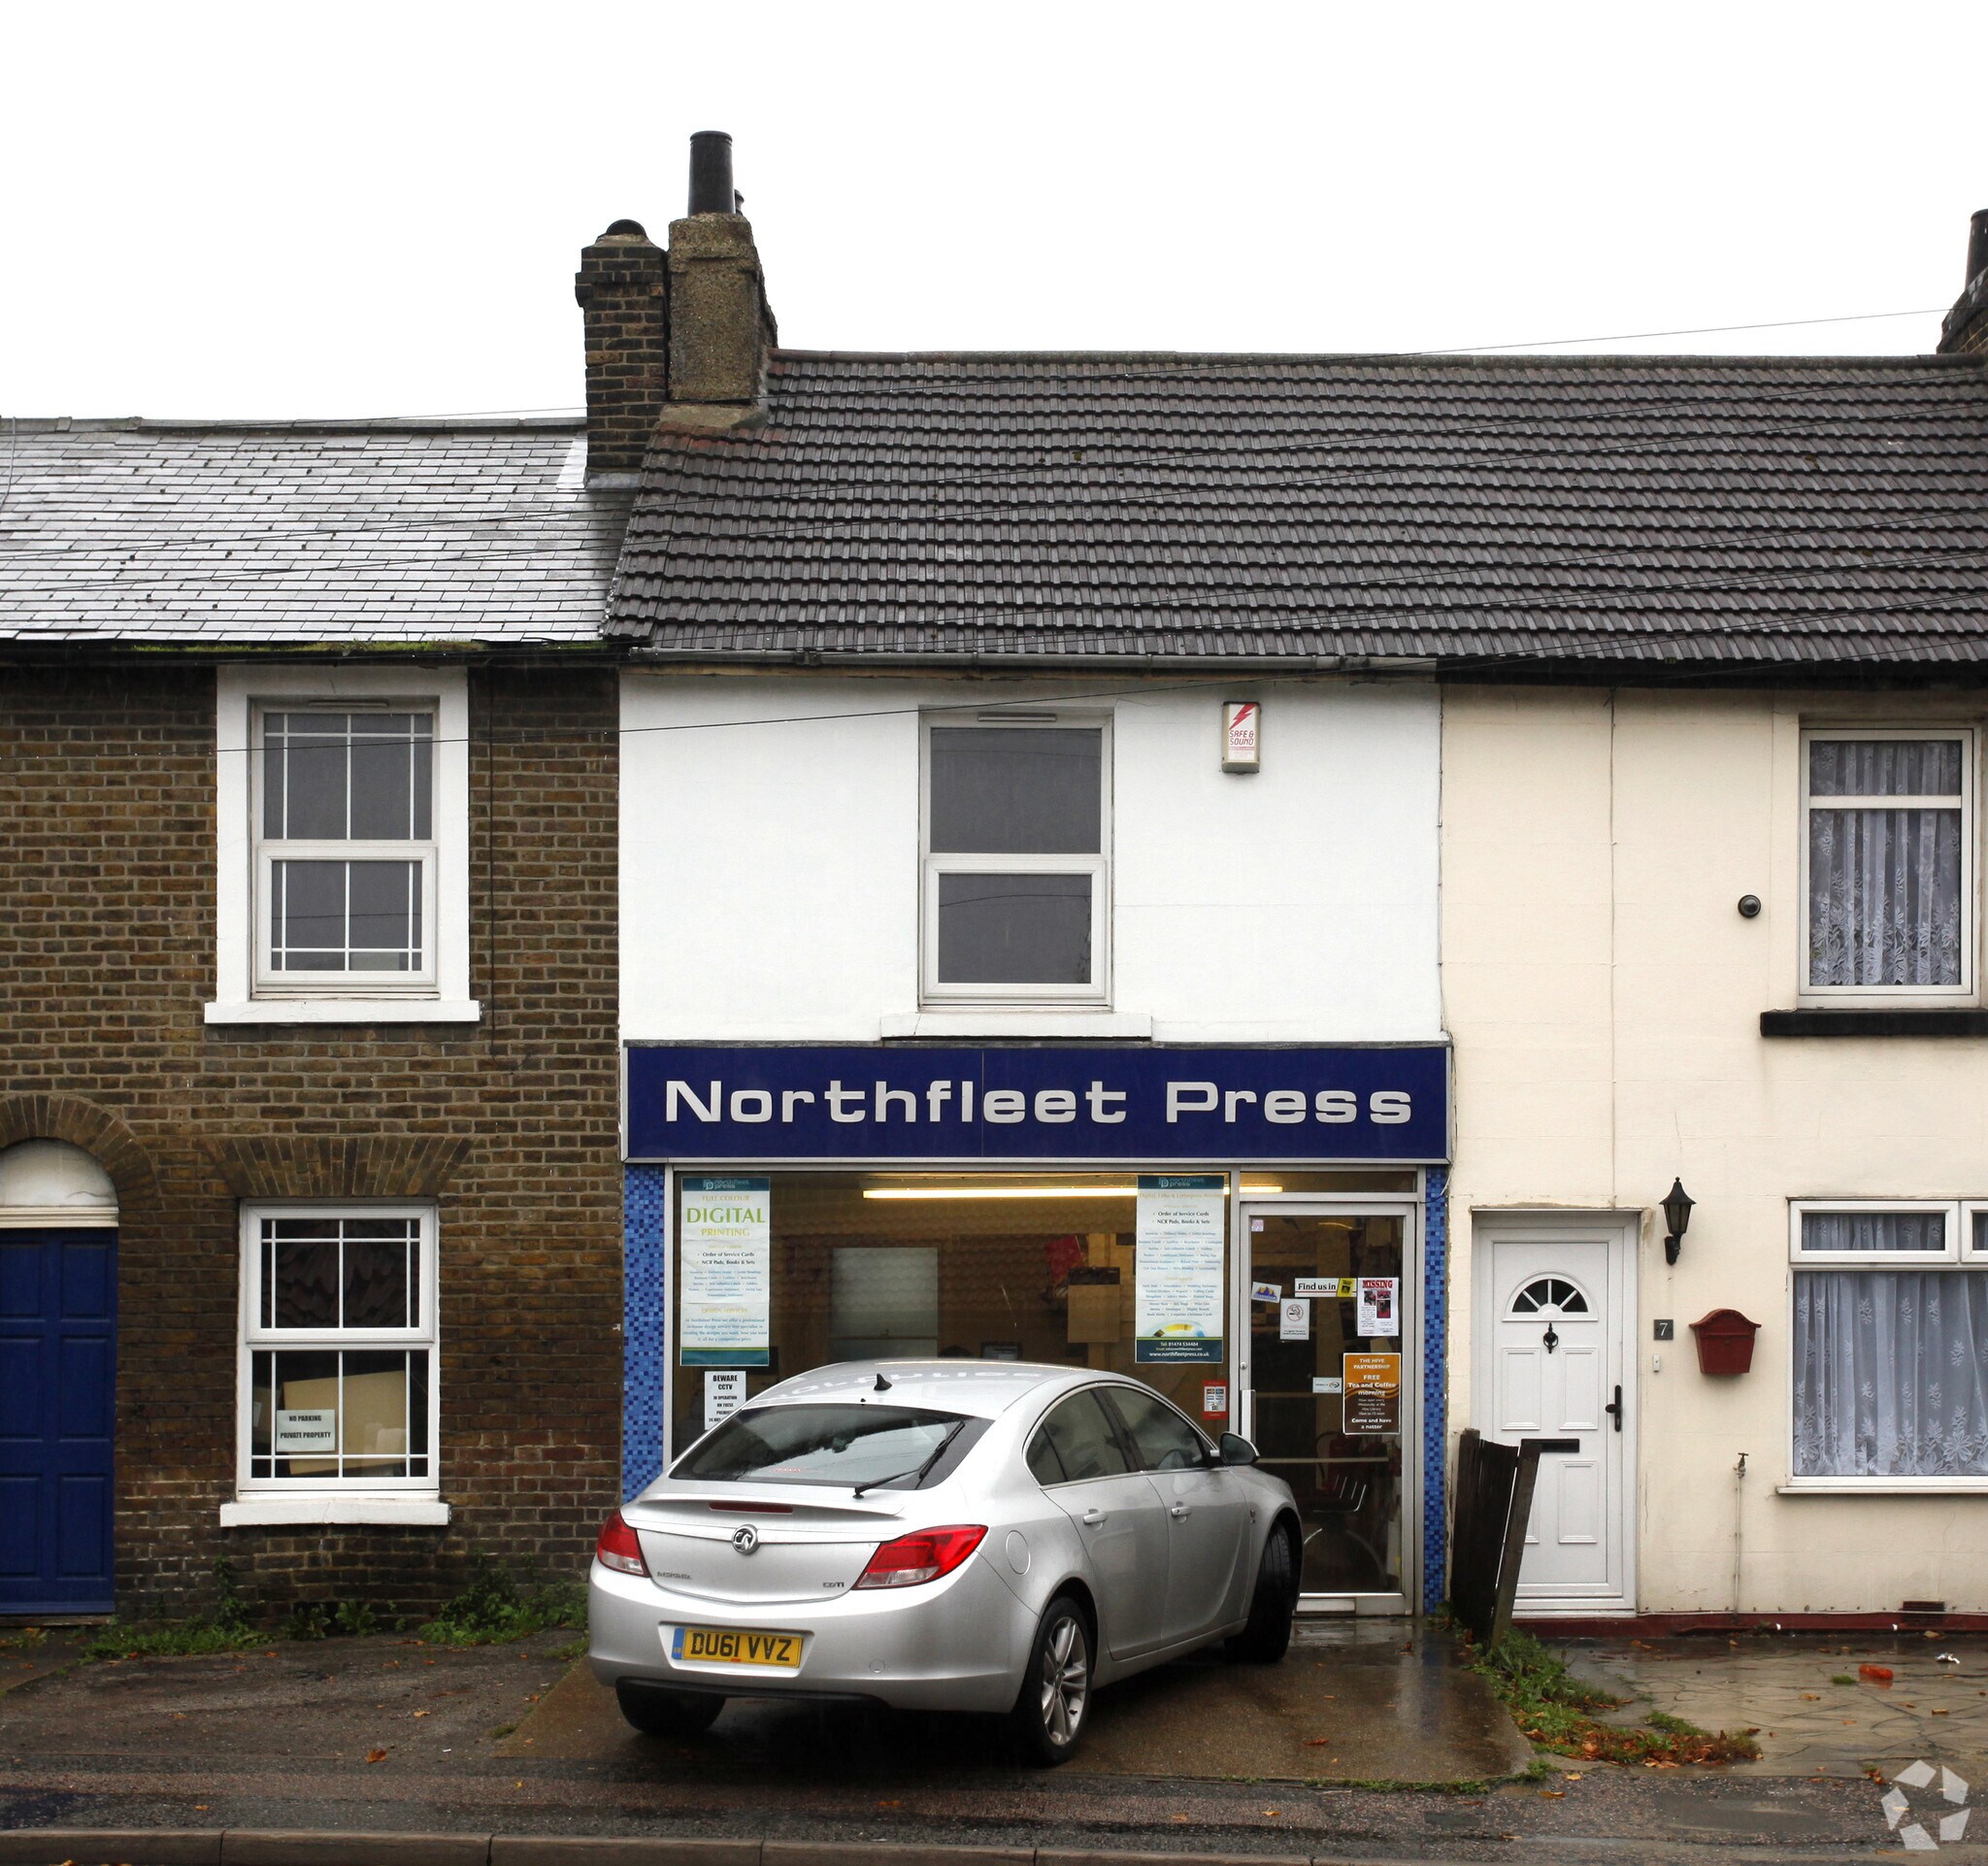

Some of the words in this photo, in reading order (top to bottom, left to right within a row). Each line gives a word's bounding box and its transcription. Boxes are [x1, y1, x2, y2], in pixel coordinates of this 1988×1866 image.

[665, 1080, 1128, 1124] Northfleet
[1166, 1080, 1412, 1124] Press
[686, 1208, 766, 1223] DIGITAL
[1363, 1280, 1392, 1289] MISSING
[1659, 1323, 1668, 1336] 7
[690, 1633, 741, 1657] DU61
[748, 1636, 792, 1661] VVZ
